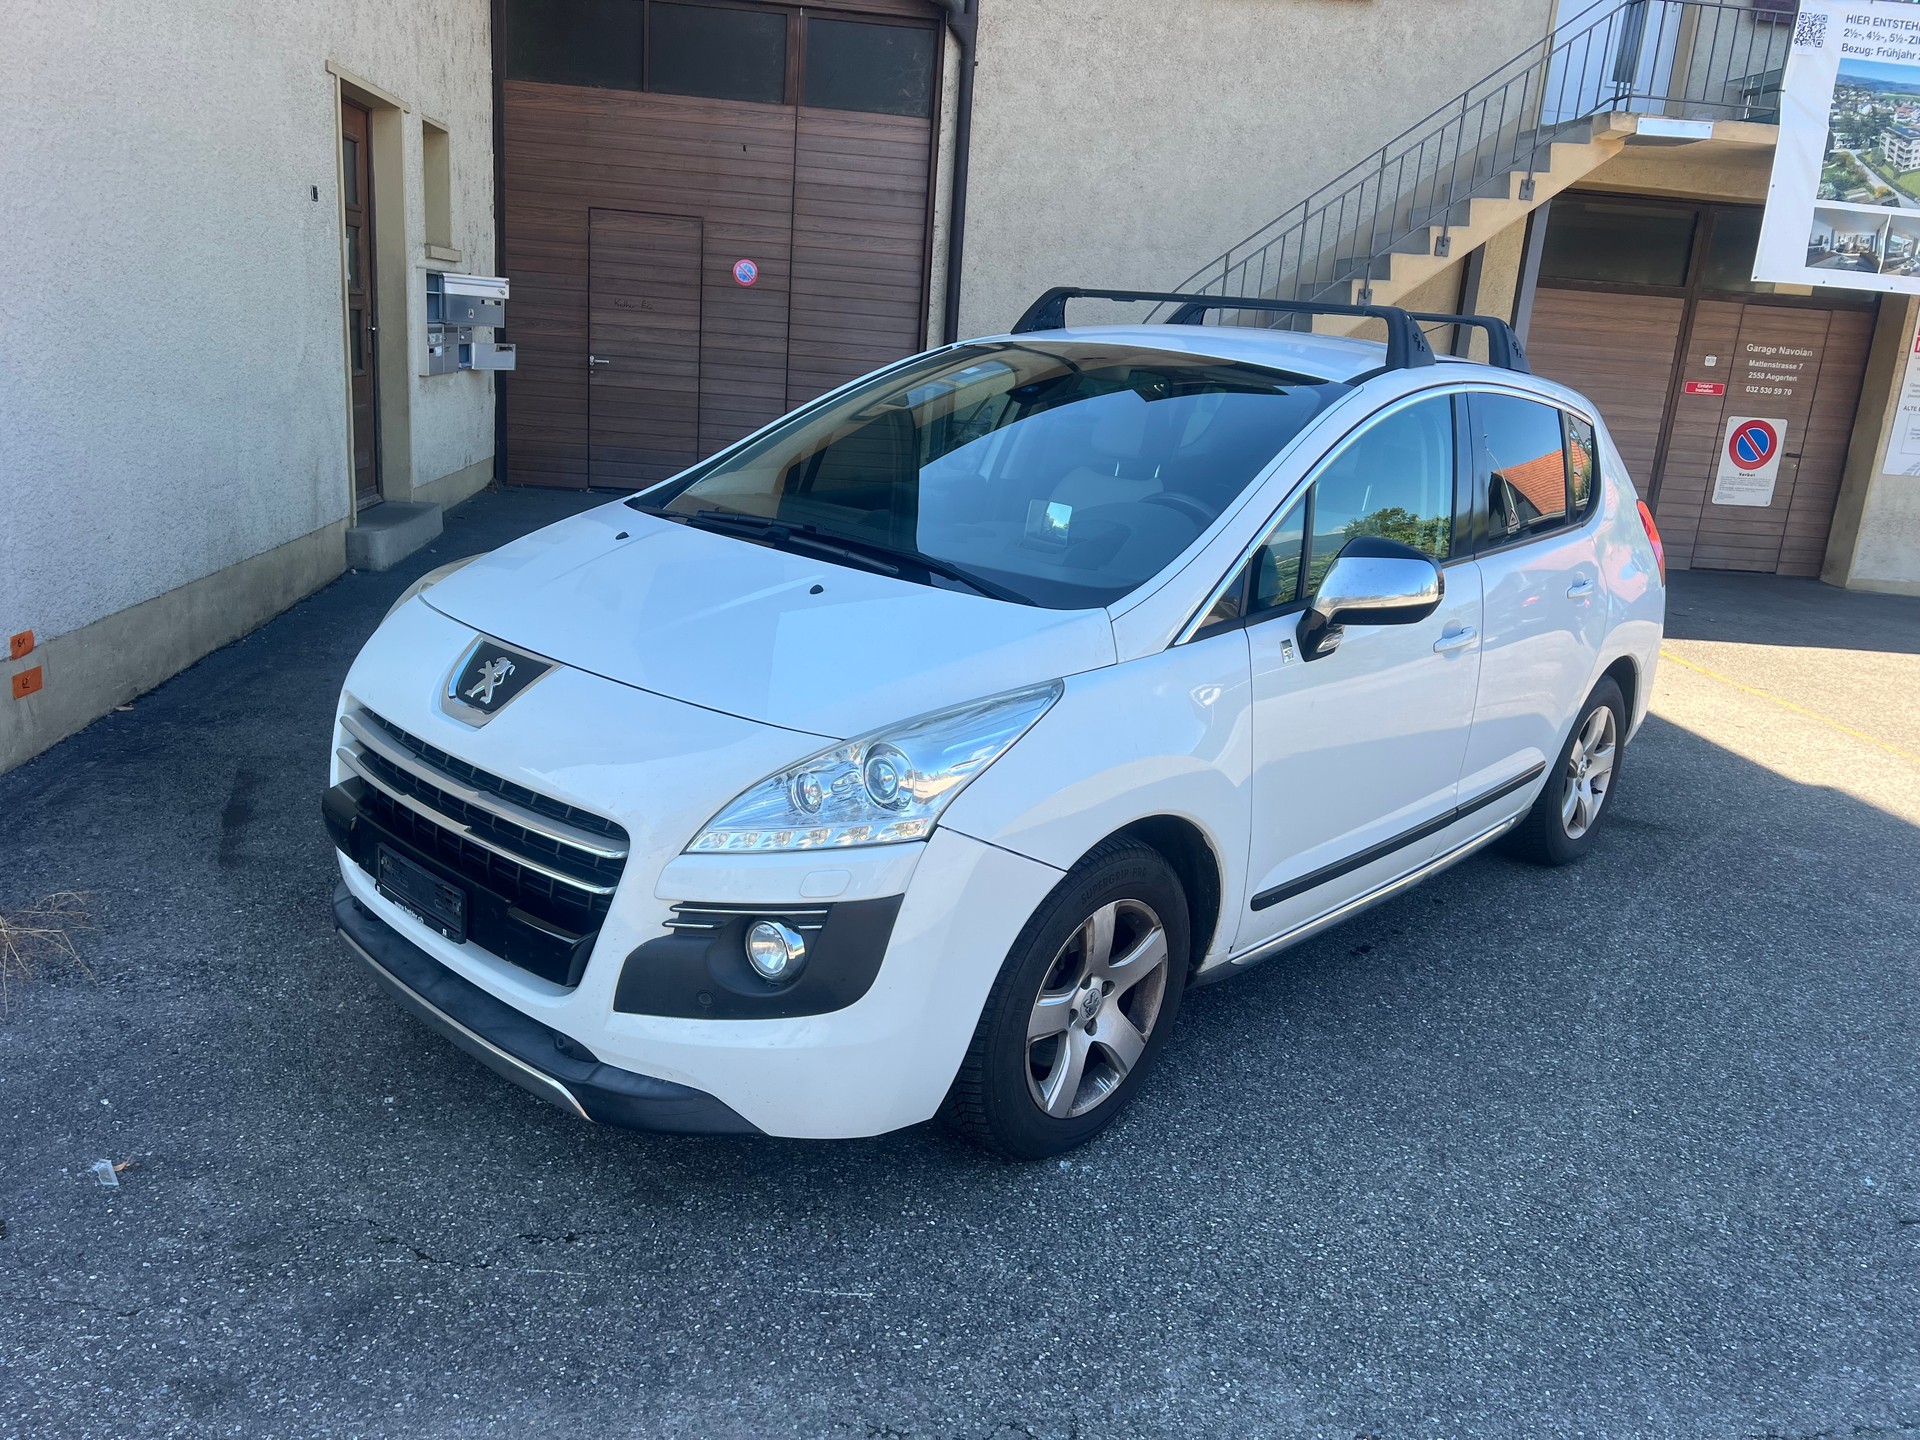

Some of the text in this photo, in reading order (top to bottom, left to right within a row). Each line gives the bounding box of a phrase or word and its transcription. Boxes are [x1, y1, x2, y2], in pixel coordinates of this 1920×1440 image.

[1845, 14, 1920, 32] HIER ENTSTEH
[1841, 42, 1874, 57] Bezug:
[1876, 46, 1917, 61] Frühjahr
[1746, 343, 1813, 357] Garage Navoian
[1748, 359, 1798, 370] Mattenstrasse
[1748, 371, 1798, 382] 2558 Aegerten
[1745, 385, 1793, 396] 032 530 59 70
[1081, 868, 1129, 905] SUPERGRIP
